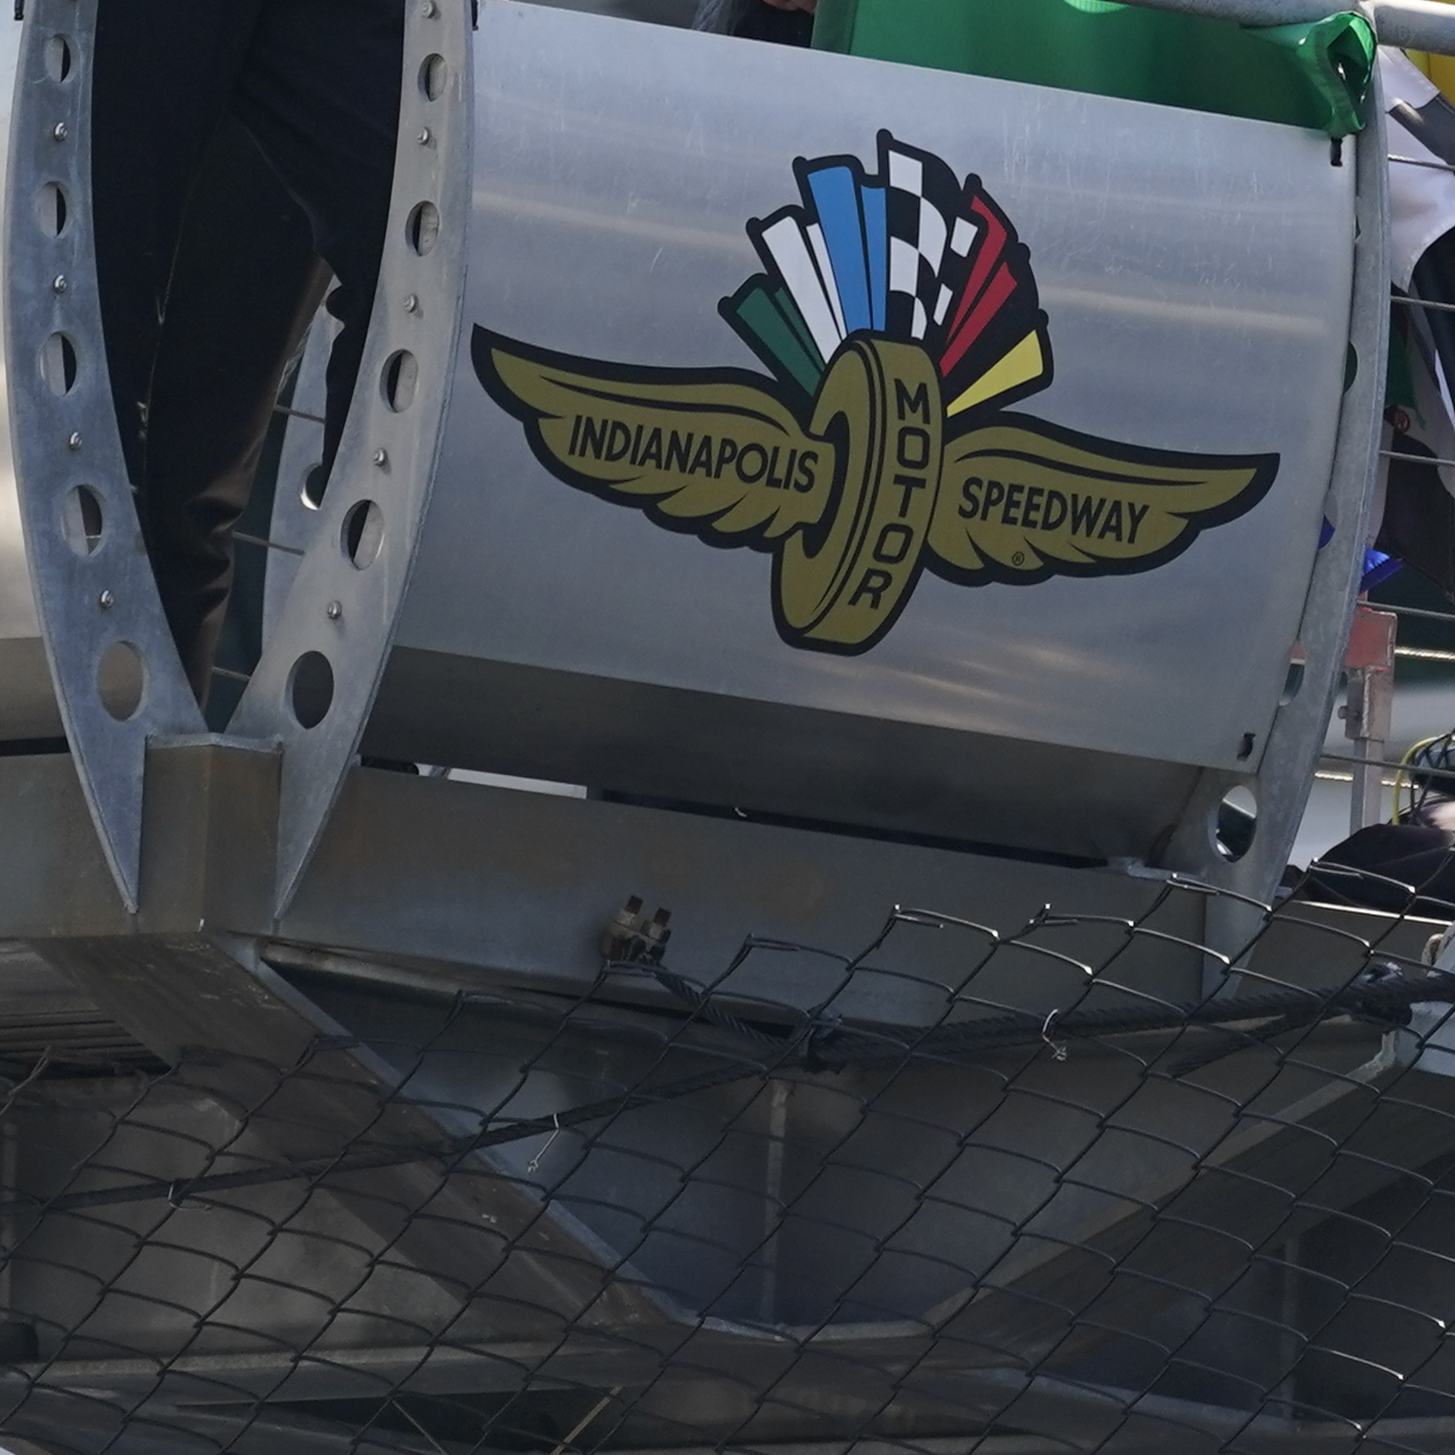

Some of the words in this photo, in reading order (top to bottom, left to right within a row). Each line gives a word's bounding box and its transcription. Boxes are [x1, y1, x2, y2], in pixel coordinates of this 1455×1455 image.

[568, 415, 818, 493] INDIANAPOLIS
[848, 378, 931, 610] MOTOR
[958, 476, 1150, 544] SPEEDWAY
